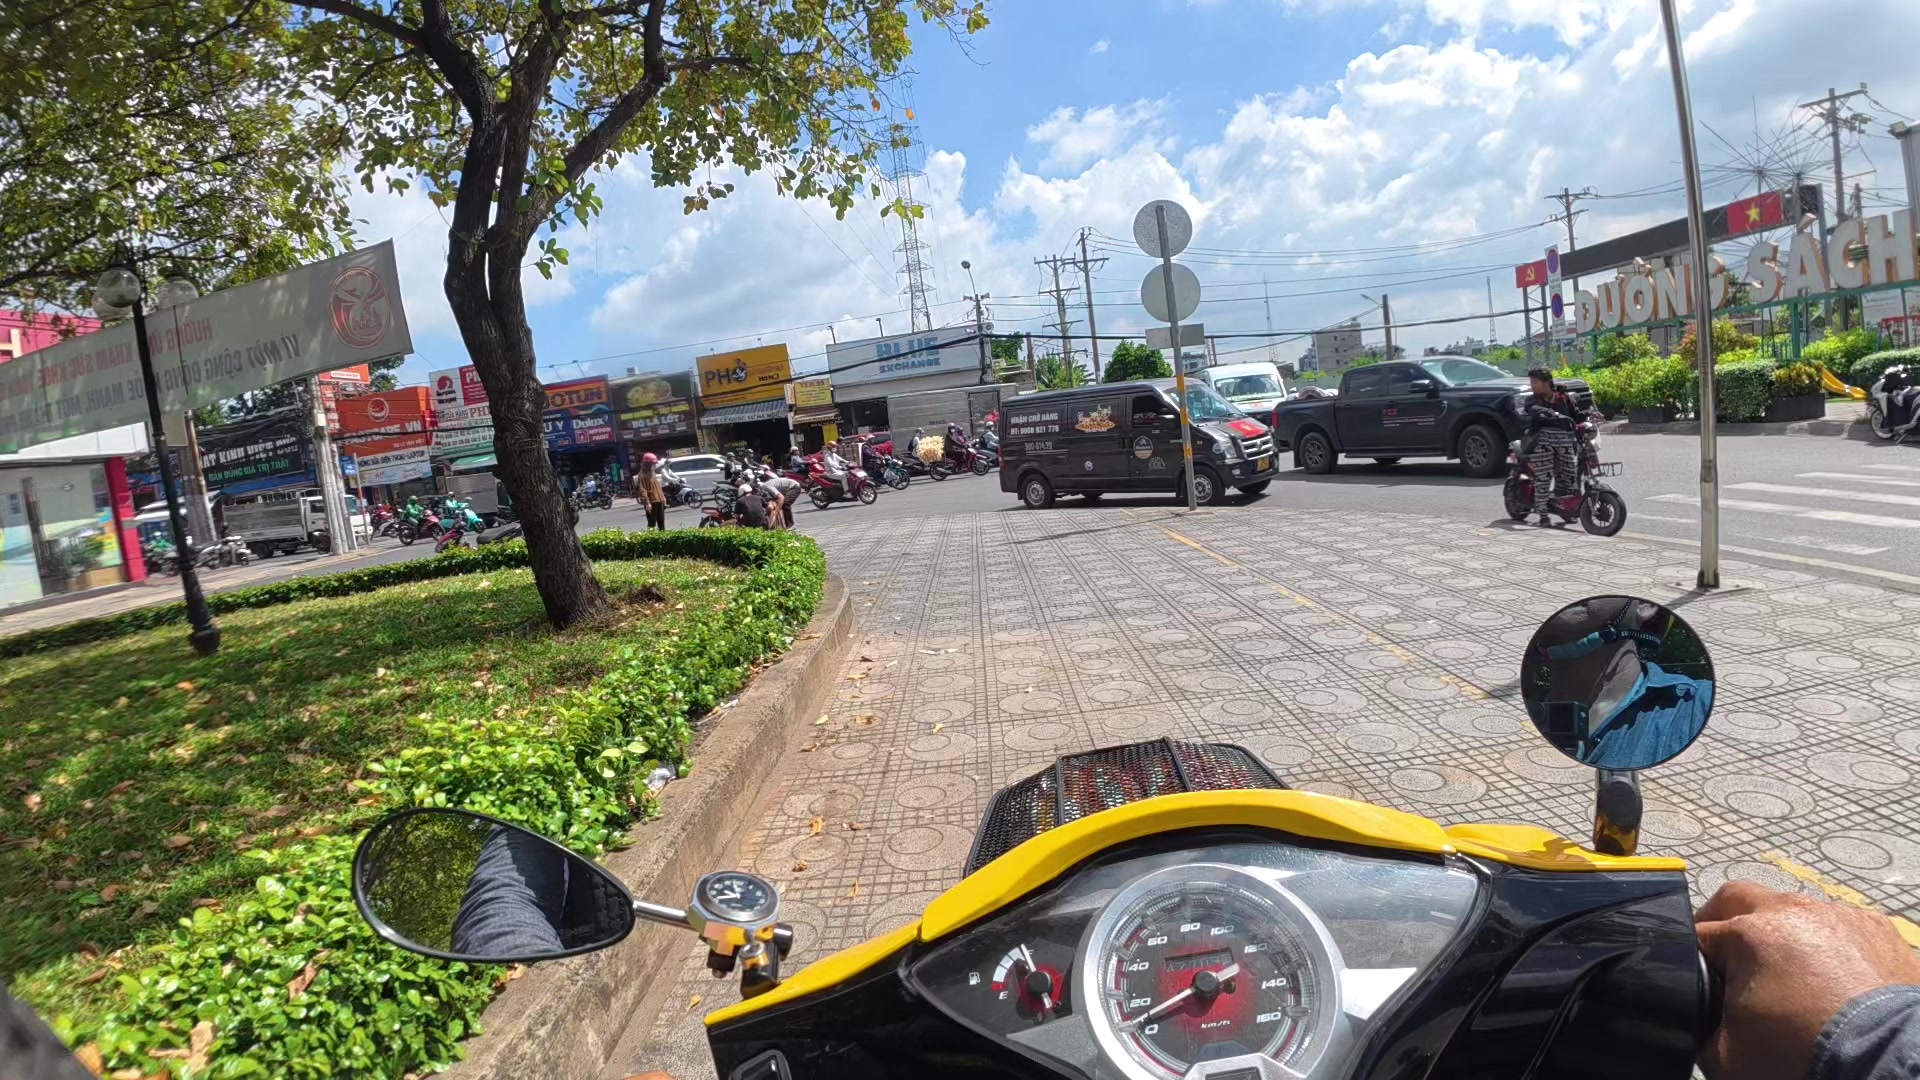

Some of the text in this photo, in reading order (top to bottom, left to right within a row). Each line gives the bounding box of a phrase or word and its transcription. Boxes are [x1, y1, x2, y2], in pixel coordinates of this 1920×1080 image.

[1747, 211, 1919, 302] SÁCH
[876, 337, 940, 359] BLUE
[880, 357, 941, 374] EXCHANGE
[572, 417, 604, 430] Dulux
[1180, 922, 1201, 932] 80
[1210, 925, 1235, 936] 100
[1147, 936, 1168, 946] 60
[1244, 942, 1268, 953] 120
[1128, 961, 1150, 972] 40
[1262, 977, 1287, 989] 140
[999, 991, 1008, 1000] E
[1130, 997, 1151, 1008] 20
[1256, 1012, 1282, 1023] 160
[1144, 1024, 1159, 1035] 0
[1201, 1020, 1231, 1029] km/h
